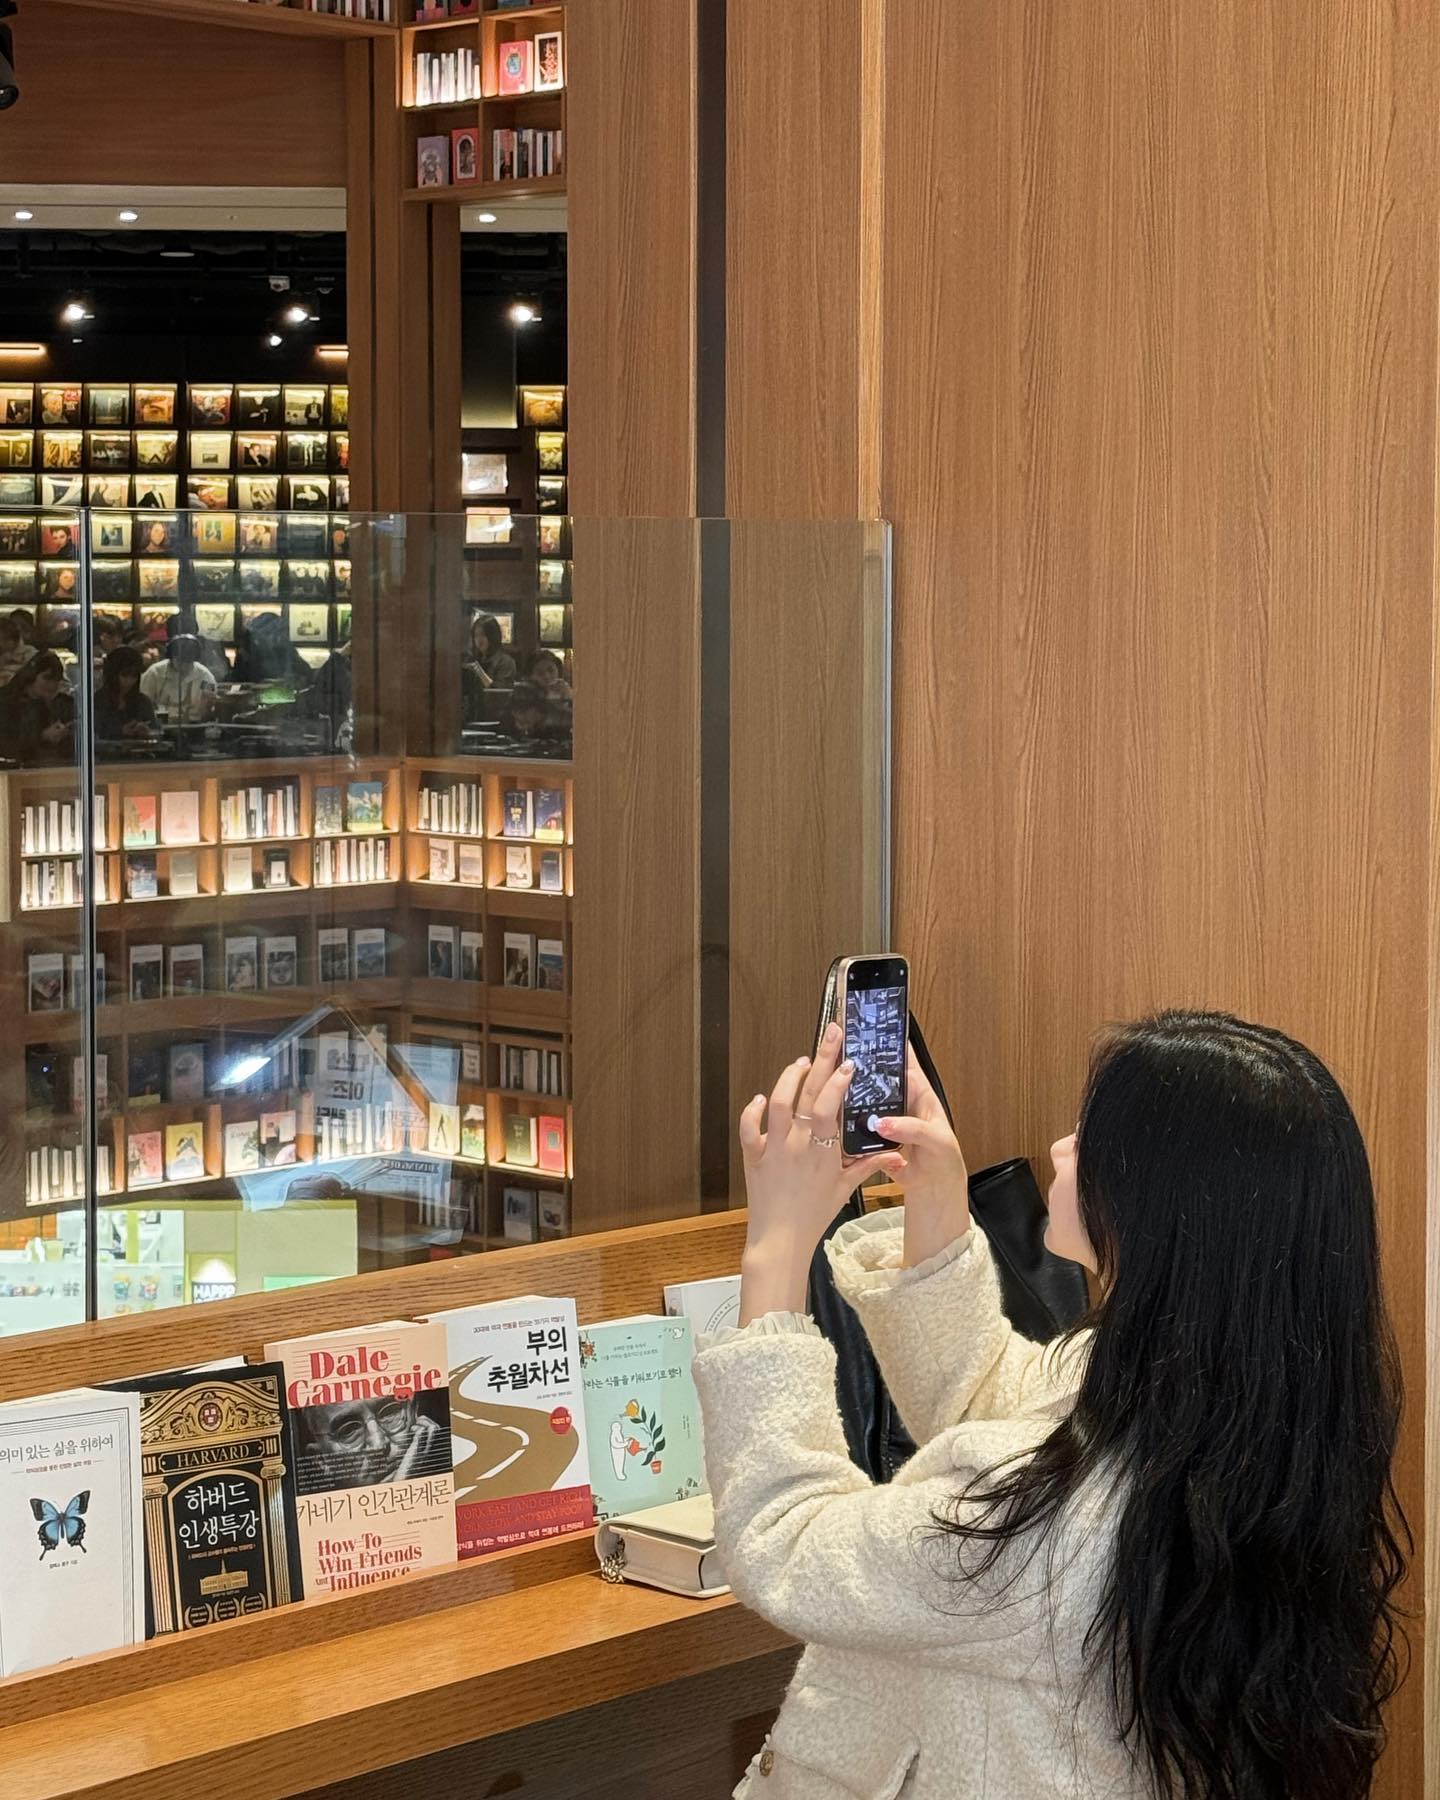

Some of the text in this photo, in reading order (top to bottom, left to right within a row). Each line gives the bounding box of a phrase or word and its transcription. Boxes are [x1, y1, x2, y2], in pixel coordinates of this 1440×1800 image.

[526, 1326, 567, 1356] 부의
[309, 1346, 389, 1380] Dale
[487, 1356, 570, 1393] 추월차선
[287, 1364, 442, 1409] Carnegie
[0, 1433, 113, 1463] 의미 있는 삶을 위하여
[177, 1444, 250, 1468] HARVARD
[184, 1482, 251, 1516] 하버드
[358, 1478, 452, 1518] 인간관계론
[179, 1510, 260, 1549] 인생특강
[318, 1532, 382, 1557] How To
[319, 1545, 422, 1575] Win Friends
